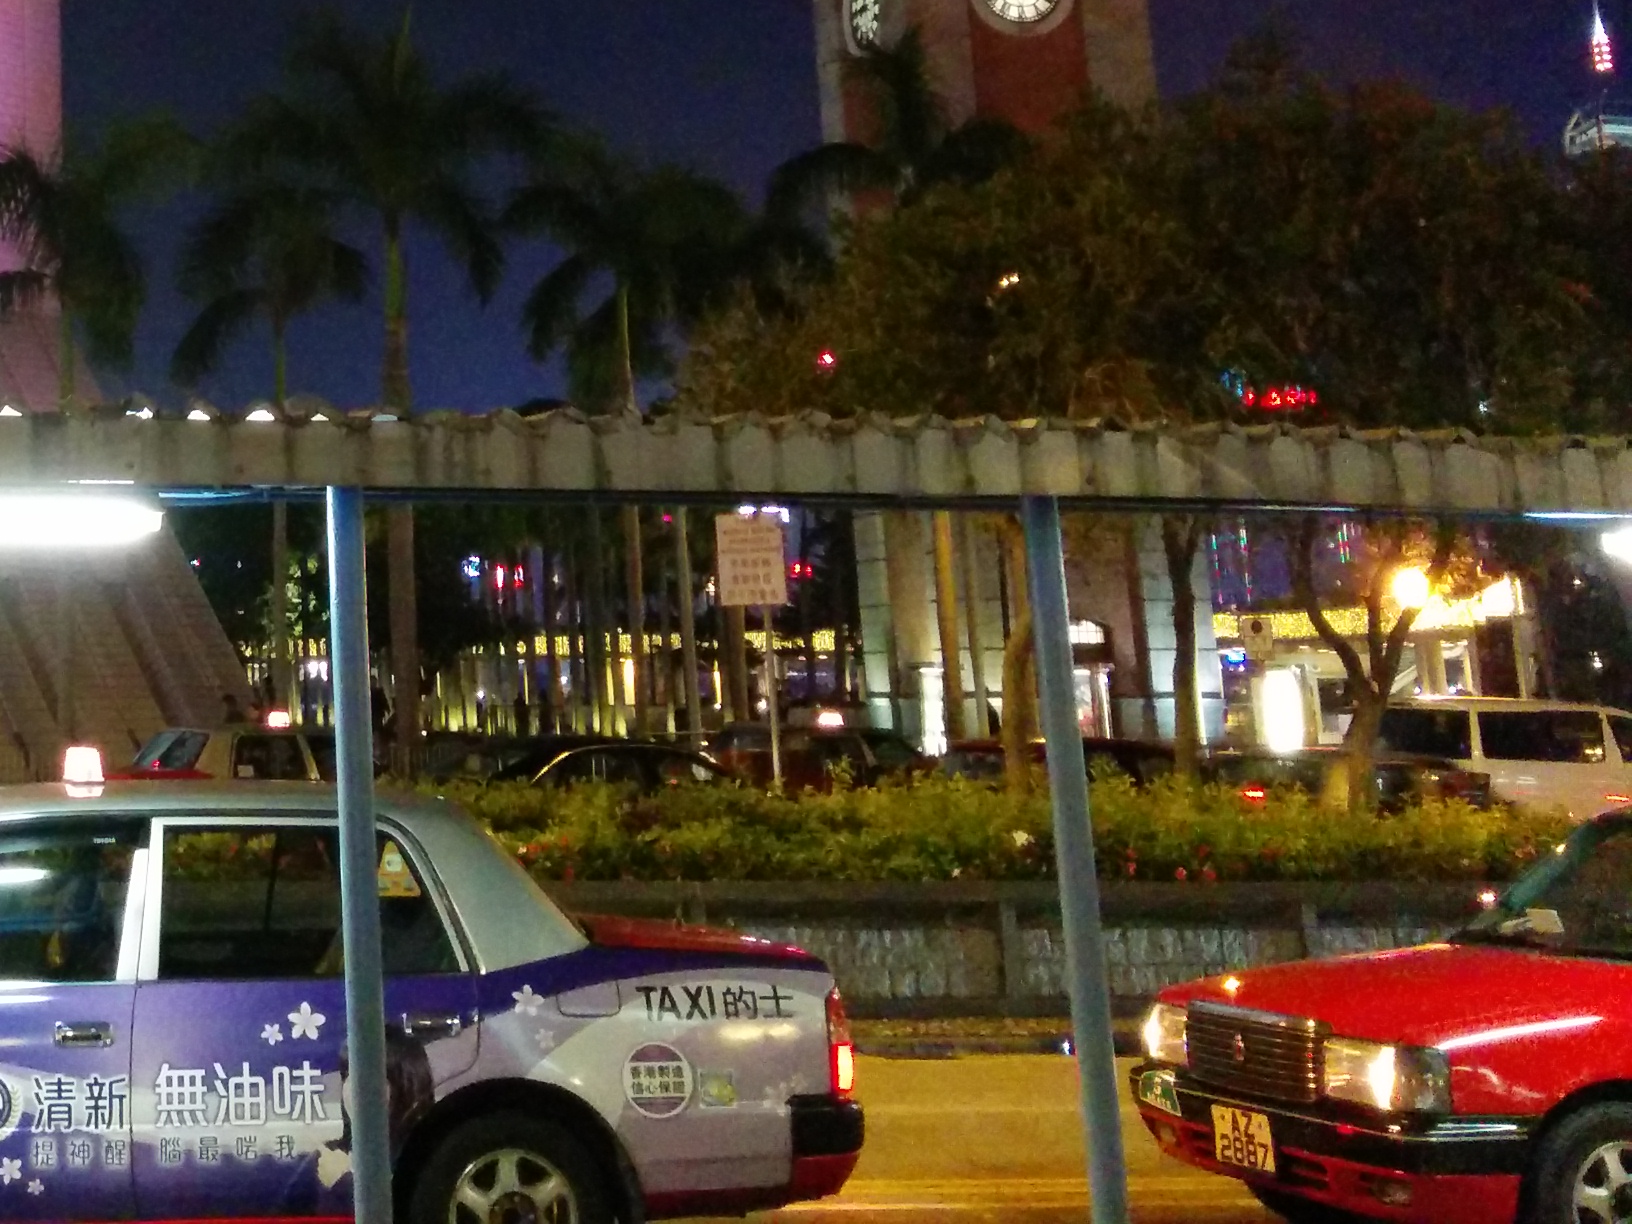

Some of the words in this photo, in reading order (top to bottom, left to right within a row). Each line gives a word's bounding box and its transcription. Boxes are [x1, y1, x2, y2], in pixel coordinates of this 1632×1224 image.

[33, 1076, 128, 1131] 清新
[154, 1060, 326, 1127] 無油味
[1231, 1110, 1253, 1140] AZ
